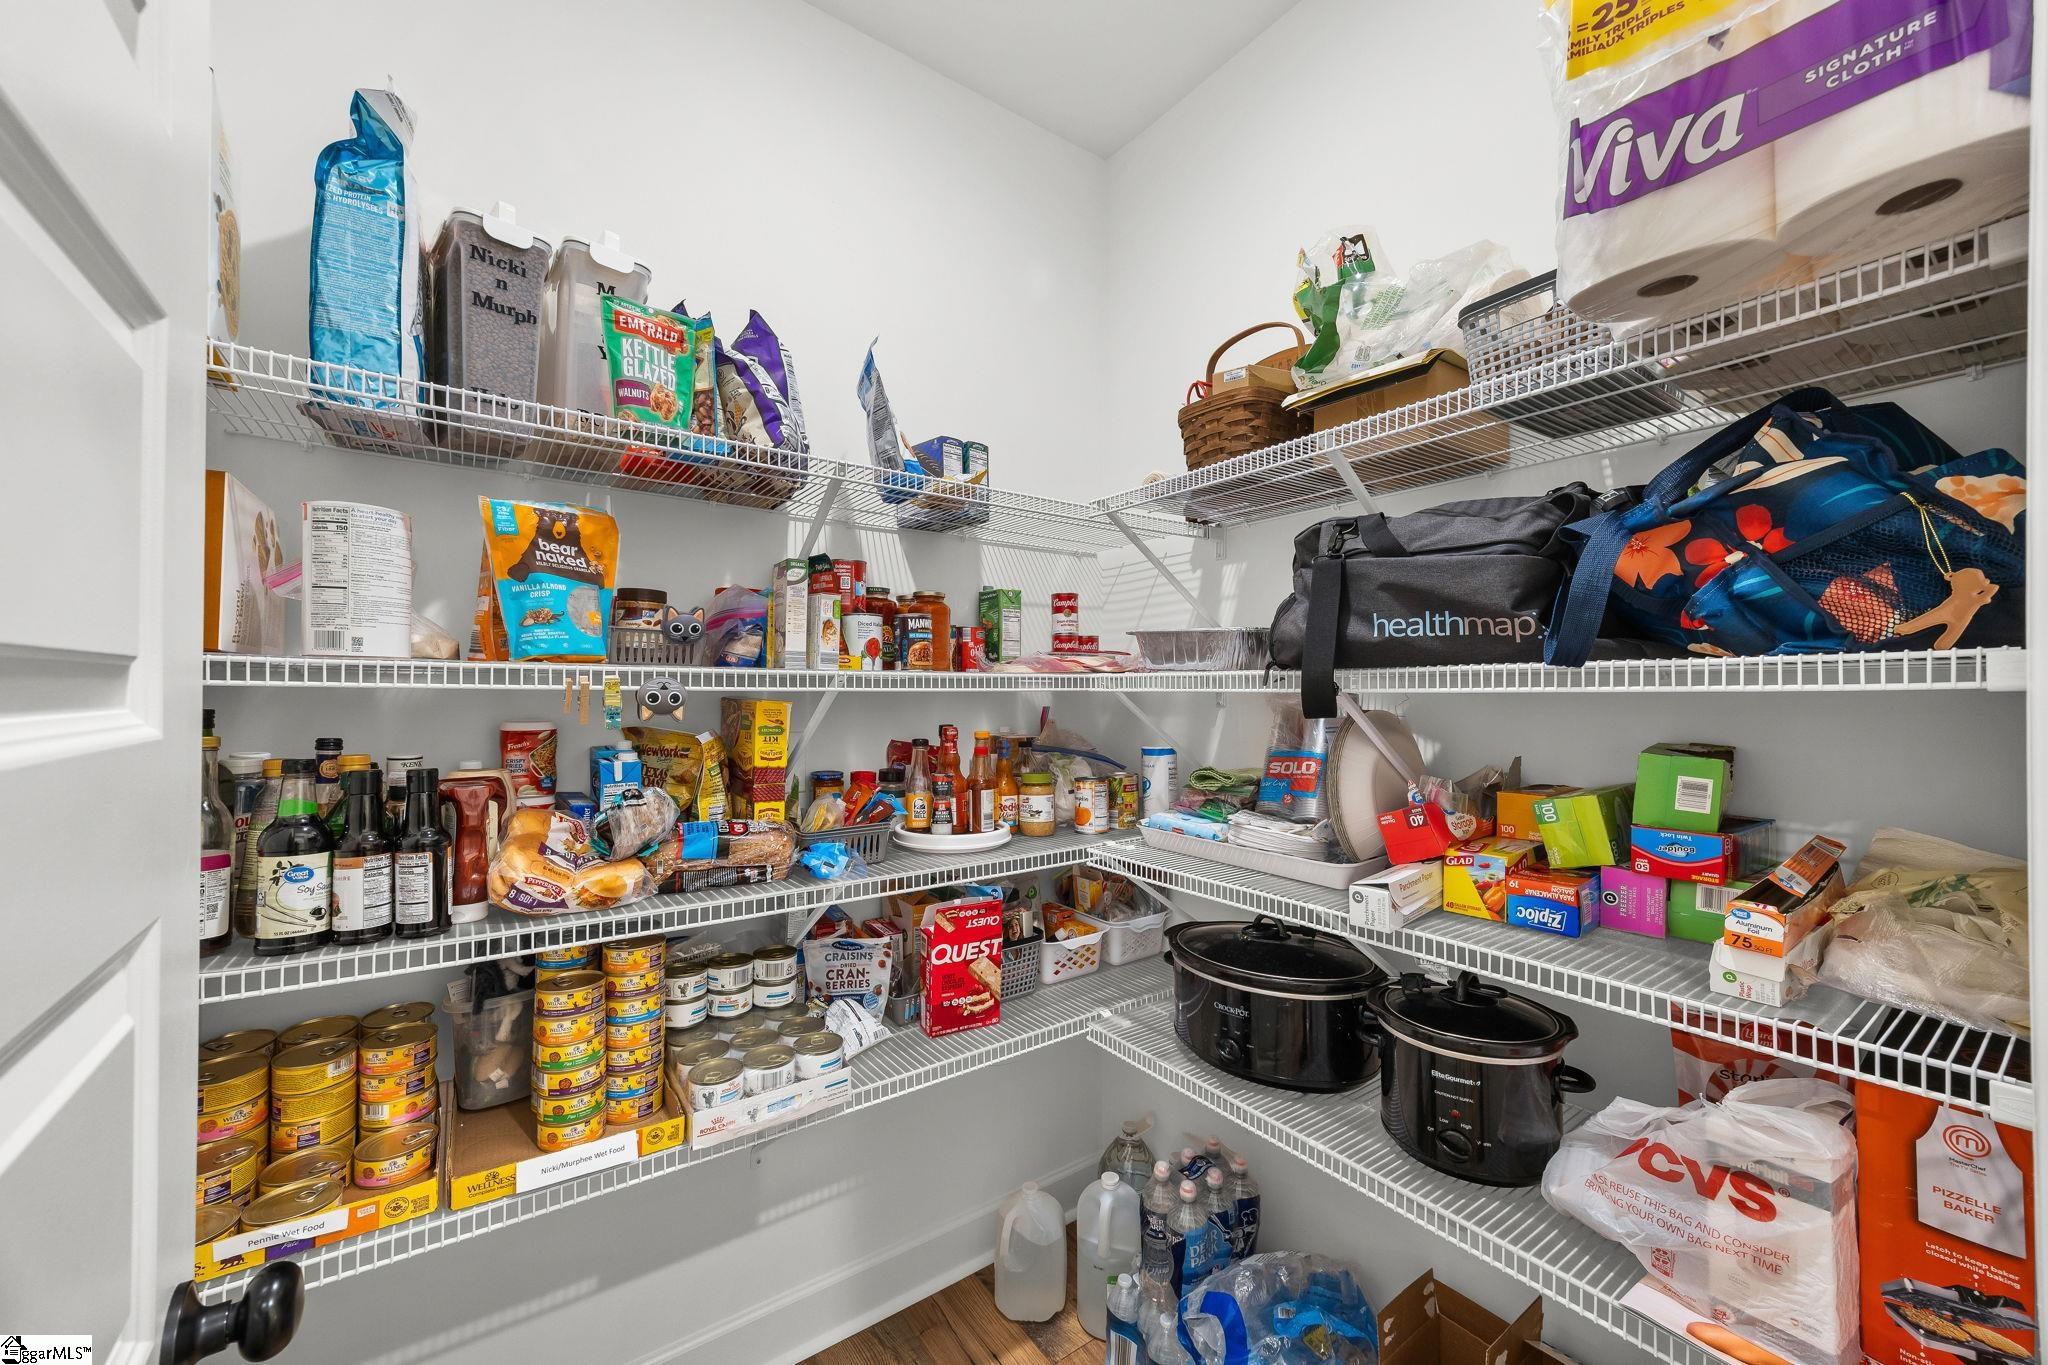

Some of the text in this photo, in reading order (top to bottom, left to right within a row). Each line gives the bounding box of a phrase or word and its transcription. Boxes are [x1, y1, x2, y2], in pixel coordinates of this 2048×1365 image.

[1567, 1, 1686, 61] MILIAUX TRIPLES
[1568, 6, 1652, 52] MILY TRIPLE
[1804, 10, 1938, 85] SIGNATURE
[1825, 45, 1900, 90] CLOTH
[1569, 90, 1746, 204] Viva
[344, 190, 372, 201] PROTEIN
[470, 243, 528, 279] Nicki
[495, 279, 509, 291] n
[471, 290, 538, 326] Murph
[618, 313, 679, 343] EMERALD
[622, 337, 677, 371] KETTLE
[622, 355, 677, 391] GLAZED
[618, 387, 650, 400] WALNUTS
[537, 537, 578, 559] bear
[535, 550, 588, 569] naked
[511, 583, 567, 593] VANILLA ALMOND
[529, 591, 551, 600] CRISP
[1372, 609, 1537, 643] healthmap
[507, 740, 531, 750] French's
[1269, 761, 1317, 775] SOLO
[1541, 802, 1557, 822] 100
[1409, 814, 1425, 828] 40
[1450, 818, 1474, 831] Storage
[1501, 825, 1515, 833] 100
[1676, 834, 1692, 842] Twin
[1657, 845, 1697, 856] Boulder
[364, 855, 383, 863] Nutrition
[1445, 856, 1474, 866] GLAD
[286, 868, 310, 878] Great
[1636, 862, 1649, 871] 50
[363, 870, 384, 878] Calories
[1691, 874, 1720, 884] STORAGE
[526, 876, 564, 896] PEPPERIDGE
[1399, 872, 1433, 892] Parchment Paper
[1509, 880, 1519, 888] 19
[297, 883, 315, 896] Soy
[508, 889, 515, 898] 8
[1524, 887, 1575, 903] PARA ALMACENAR
[1619, 884, 1628, 918] FREEZER
[965, 915, 1001, 929] QUEST
[1516, 906, 1563, 929] Ziploc
[1735, 918, 1773, 933] Aluminum
[1747, 927, 1761, 935] Foil
[1730, 933, 1753, 949] 75
[824, 951, 874, 962] CRAISINS
[931, 938, 1003, 966] QUEST
[825, 967, 870, 981] CRAN-
[825, 979, 871, 990] BERRIES
[564, 1048, 589, 1057] WELLNESS
[365, 1055, 389, 1065] WELLNESS
[575, 1071, 599, 1083] WELLNESS
[1433, 1089, 1451, 1098] CAUTION
[569, 1100, 593, 1110] WELLNESS
[222, 1111, 255, 1125] WELLNESS
[1438, 1116, 1449, 1124] Low
[561, 1128, 587, 1139] WELLNESS
[699, 1126, 718, 1136] ROYAL
[1460, 1122, 1473, 1131] High
[540, 1144, 626, 1175] Nicki/Murphee Wet Food
[1948, 1156, 1987, 1172] MasterChef
[378, 1161, 409, 1174] WELLNESS
[1969, 1169, 1988, 1178] Series
[466, 1172, 517, 1195] WELLNESS
[1637, 1141, 1778, 1223] CVS
[467, 1186, 497, 1199] Complete
[1932, 1184, 2003, 1216] PIZZELLE
[1943, 1199, 1996, 1225] BAKER
[1608, 1178, 1791, 1264] REUSE THIS BAG AND CONSIDER
[247, 1221, 326, 1248] Pennie Wet Food
[1624, 1201, 1784, 1276] YOUR OWN BAG NEXT TIME
[1925, 1241, 2021, 1282] Latch to keep baker
[1924, 1248, 2022, 1290] closed while baking
